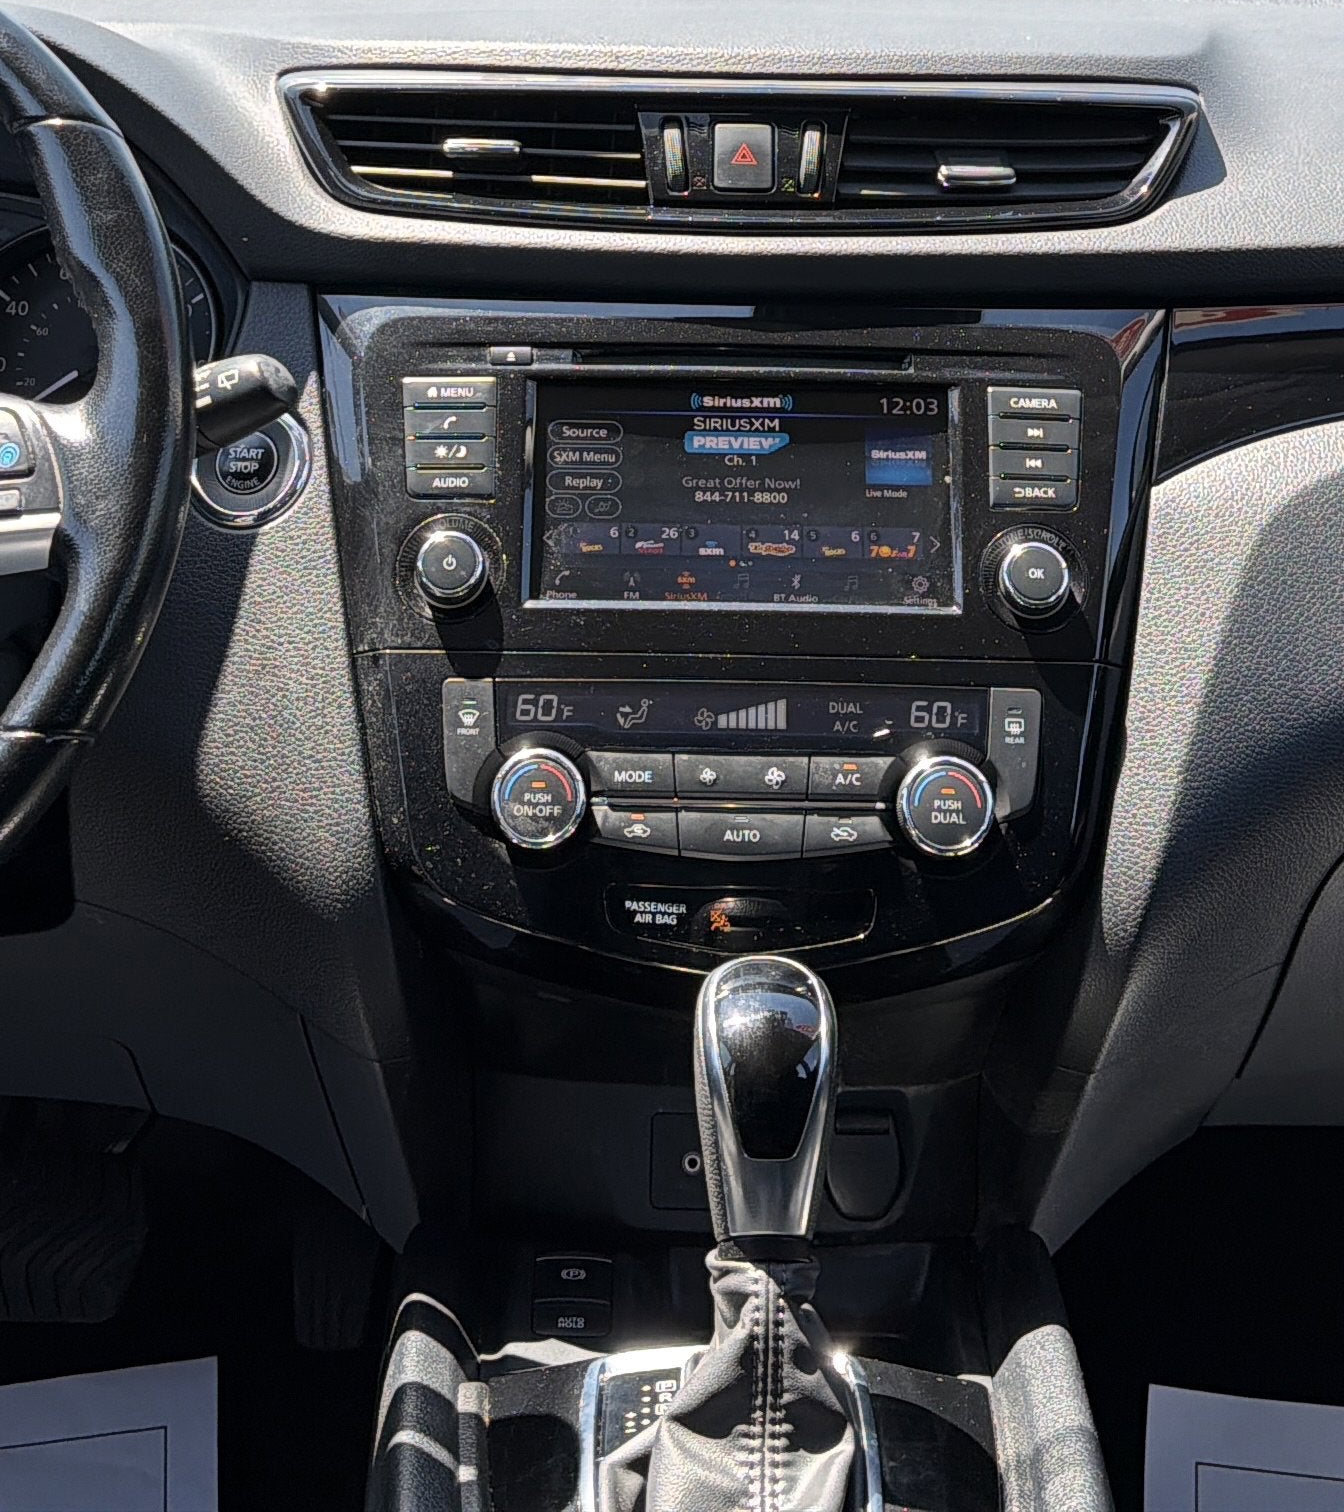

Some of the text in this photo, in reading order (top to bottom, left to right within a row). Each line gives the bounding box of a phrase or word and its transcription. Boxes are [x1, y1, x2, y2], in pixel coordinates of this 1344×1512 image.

[5, 300, 30, 317] 40
[36, 327, 49, 336] 60
[440, 386, 474, 399] MENU
[879, 397, 939, 416] 12:03
[1009, 397, 1058, 410] CAMERA
[693, 417, 780, 432] SIRIUSXM
[562, 425, 608, 439] Source
[693, 436, 781, 450] PREVIEW
[229, 448, 264, 459] START
[554, 451, 616, 464] SXM Menu
[724, 454, 747, 467] Ch.
[229, 461, 260, 474] STOP
[226, 474, 261, 489] ENGINE
[432, 476, 470, 489] AUDIO
[564, 474, 605, 490] Replay
[682, 476, 801, 489] Great Offer Now!
[694, 491, 788, 504] 844-711-8800
[865, 489, 887, 499] Live
[1024, 487, 1057, 499] BACK
[609, 526, 619, 538] 6
[661, 527, 679, 539] 26
[783, 529, 800, 541] 14
[851, 531, 861, 543] 6
[911, 531, 921, 544] 7
[1028, 568, 1045, 580] OK
[546, 590, 578, 600] Phone
[624, 591, 640, 600] FM
[773, 593, 819, 604] BT Audio
[828, 701, 864, 715] DUAL
[456, 727, 480, 736] FRONT
[833, 721, 859, 733] A/C
[613, 770, 654, 784] MODE
[835, 772, 862, 786] A/C
[523, 792, 552, 804] PUSH
[933, 799, 962, 810] PUSH
[931, 811, 967, 825] DUAL
[723, 829, 761, 843] AUTO
[624, 900, 687, 914] PASSENGER
[633, 913, 678, 926] AIR BAG
